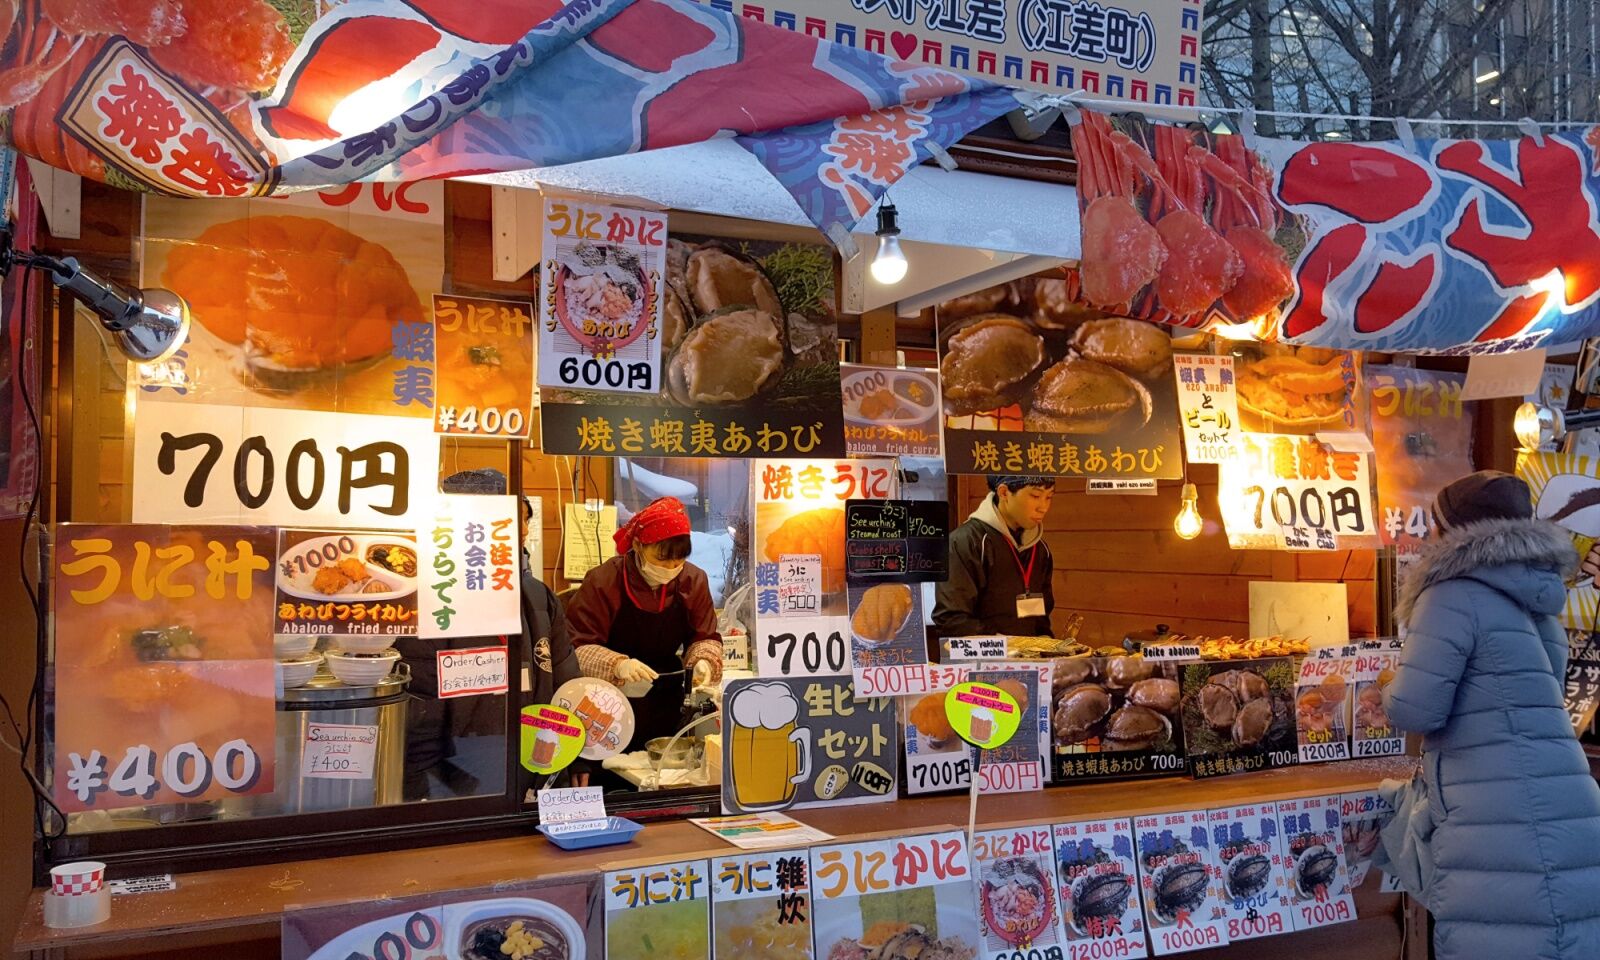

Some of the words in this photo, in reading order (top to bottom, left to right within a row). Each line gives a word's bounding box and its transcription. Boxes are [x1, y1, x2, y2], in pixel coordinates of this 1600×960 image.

[435, 300, 531, 338] うに汁
[559, 356, 652, 390] 600円
[1201, 393, 1214, 409] と
[438, 405, 524, 434] ¥400
[1184, 408, 1231, 430] ビール
[577, 415, 825, 455] 焼き蝦夷あわび
[972, 440, 1165, 474] 焼き蝦夷あわび
[157, 431, 410, 517] 700円
[762, 464, 889, 501] 焼きうに
[1241, 485, 1365, 533] 700円
[1385, 504, 1437, 540] ¥4
[278, 534, 355, 580] ¥1000
[464, 521, 488, 591] お会計
[489, 518, 514, 592] ご注文
[60, 538, 271, 605] うに汁
[788, 564, 806, 577] うに
[282, 623, 334, 635] Abalone
[347, 622, 380, 635] fried
[767, 631, 846, 675] 700
[978, 639, 1004, 649] yakiuni
[981, 648, 1005, 657] urchin
[1168, 645, 1200, 658] abalone
[862, 664, 928, 695] 500円
[817, 723, 888, 760] セット
[1306, 727, 1333, 743] セット
[1365, 724, 1391, 739] セット
[1302, 742, 1346, 761] 1200円
[1357, 739, 1402, 755] 1200円
[66, 738, 263, 806] ¥400
[978, 761, 1040, 791] 500円
[1061, 755, 1146, 777] 焼き蝦夷あわび
[1150, 754, 1185, 770] 700円
[1195, 754, 1265, 778] 焼き蝦夷あわび
[1268, 750, 1299, 766] 700円
[611, 864, 703, 908] うに汁
[1233, 891, 1268, 911] あわび
[1301, 899, 1350, 926] 700円
[1084, 913, 1124, 940] 特大
[1162, 925, 1220, 950] 1000円
[1228, 911, 1283, 939] 800円
